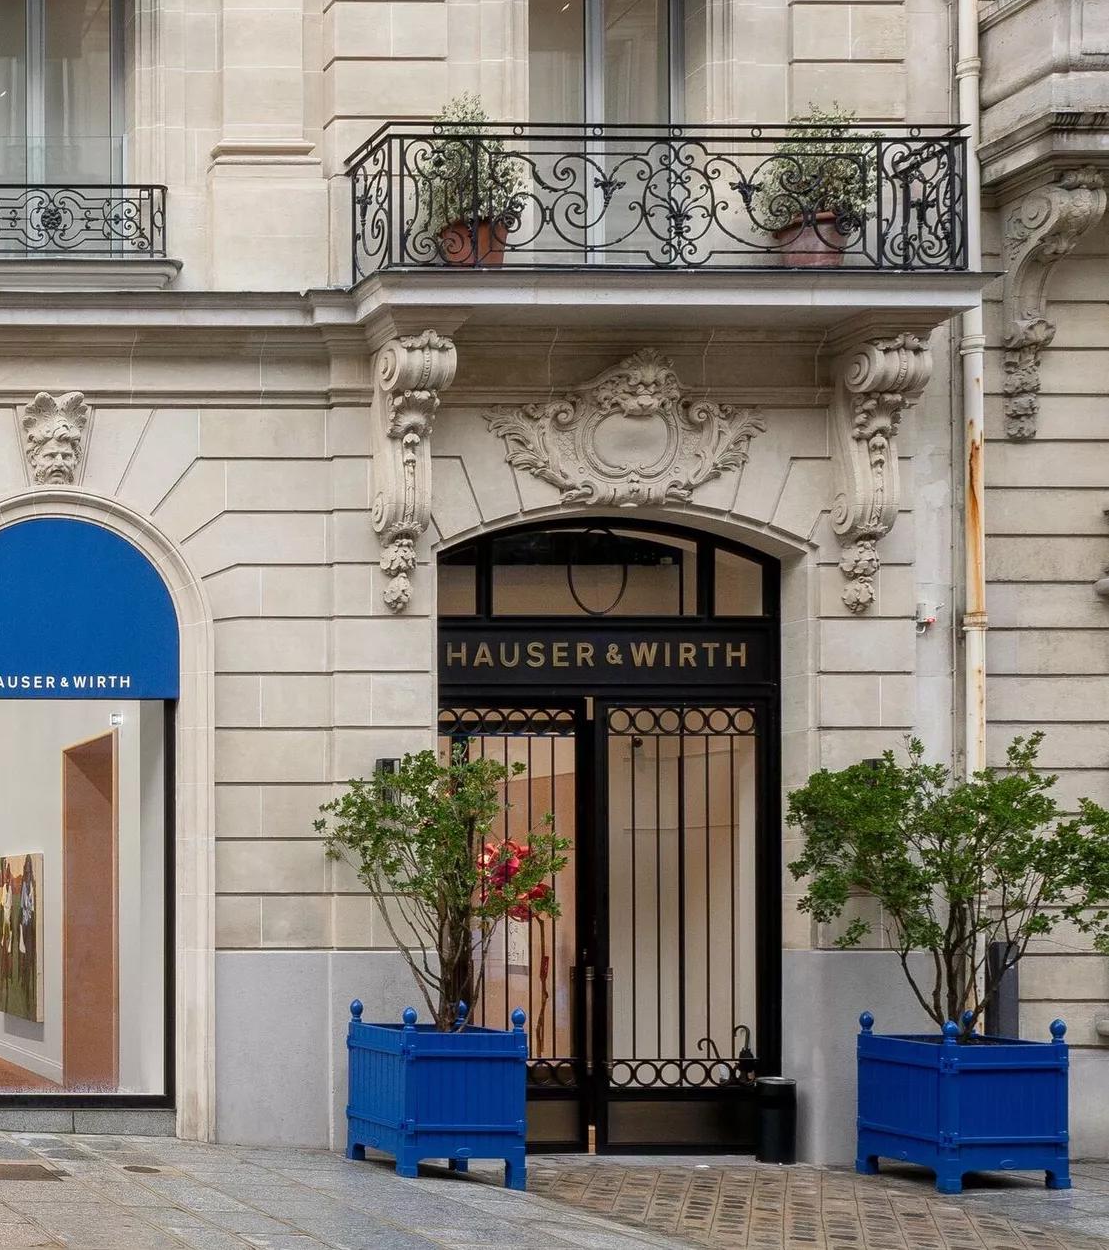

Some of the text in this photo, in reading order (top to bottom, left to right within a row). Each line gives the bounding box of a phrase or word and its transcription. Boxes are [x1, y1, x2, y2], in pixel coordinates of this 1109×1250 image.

[446, 641, 747, 668] HAUSER & WIRTH
[60, 676, 69, 689] &
[72, 675, 130, 689] WIRTH
